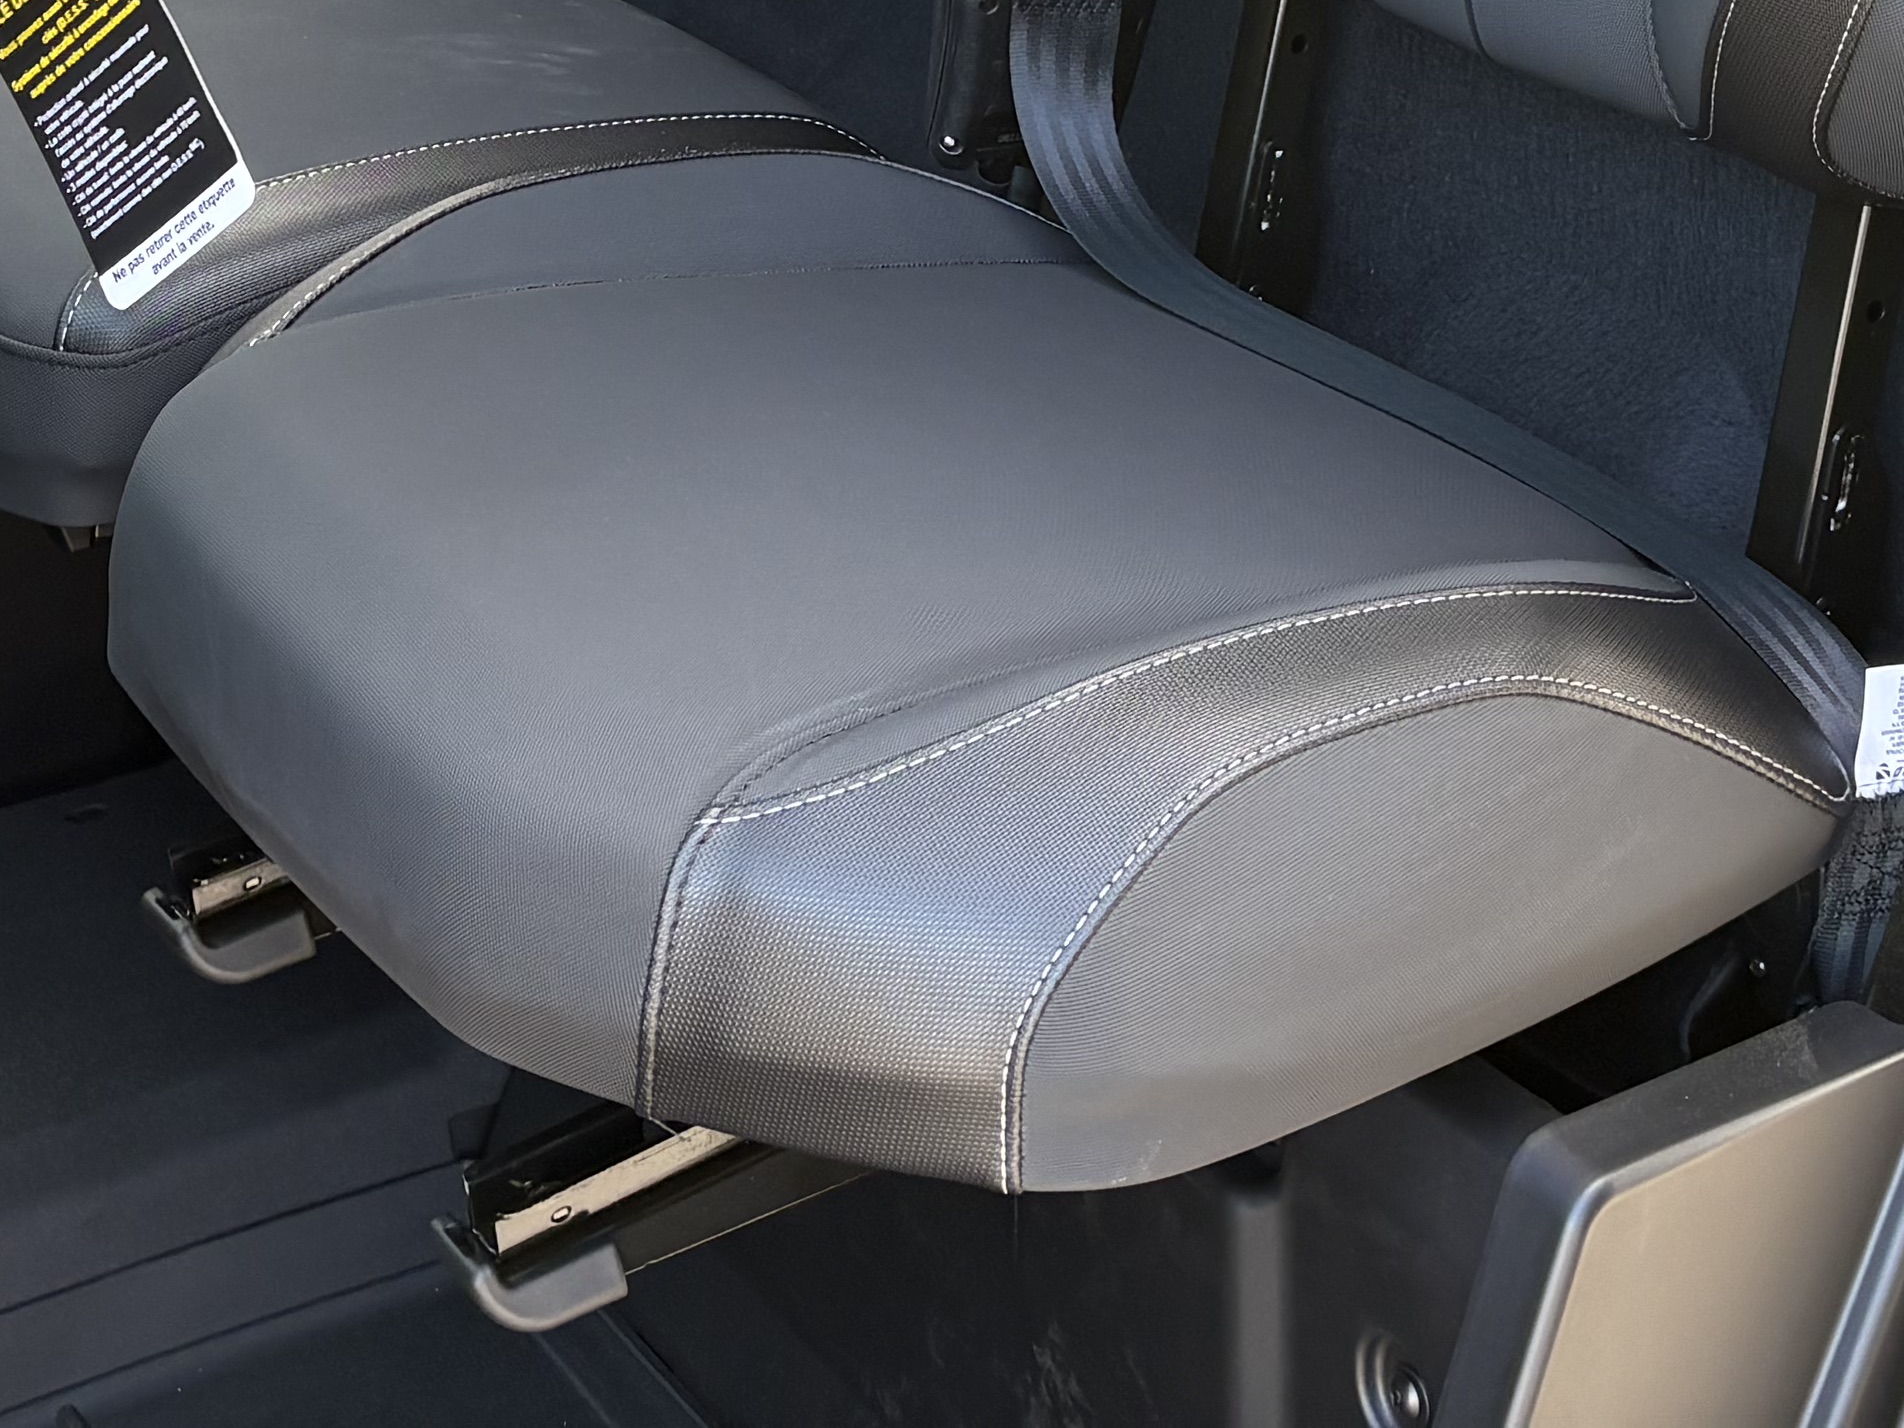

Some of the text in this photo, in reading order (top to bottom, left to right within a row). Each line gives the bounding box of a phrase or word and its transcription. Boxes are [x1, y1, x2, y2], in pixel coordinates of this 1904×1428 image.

[112, 268, 125, 282] Ne
[128, 253, 144, 273] pas
[146, 229, 172, 256] retirer
[174, 211, 196, 233] cette
[152, 221, 214, 274] avant la vente.
